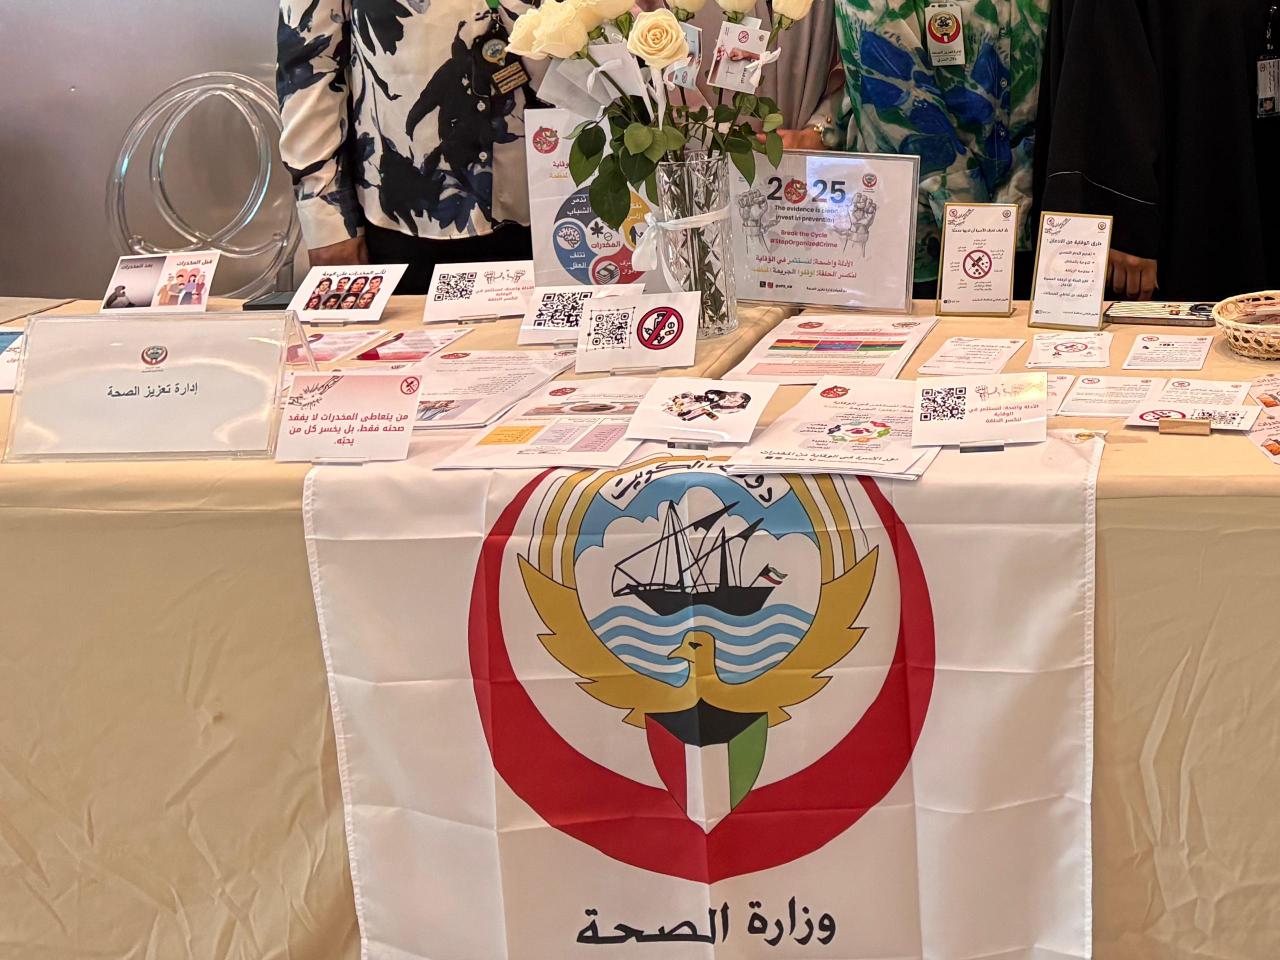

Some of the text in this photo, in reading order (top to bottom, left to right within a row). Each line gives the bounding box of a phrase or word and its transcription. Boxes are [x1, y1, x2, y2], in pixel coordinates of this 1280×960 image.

[107, 381, 198, 398] إدارة تعزيز الصحة
[311, 413, 319, 421] لا
[320, 413, 358, 423] المخدرات
[360, 413, 393, 423] يتعاطى
[395, 414, 409, 422] من
[289, 426, 302, 435] من
[304, 425, 317, 435] كل
[319, 425, 341, 435] يخسر
[344, 425, 355, 435] بل
[576, 896, 837, 946] وزارة الصحة
